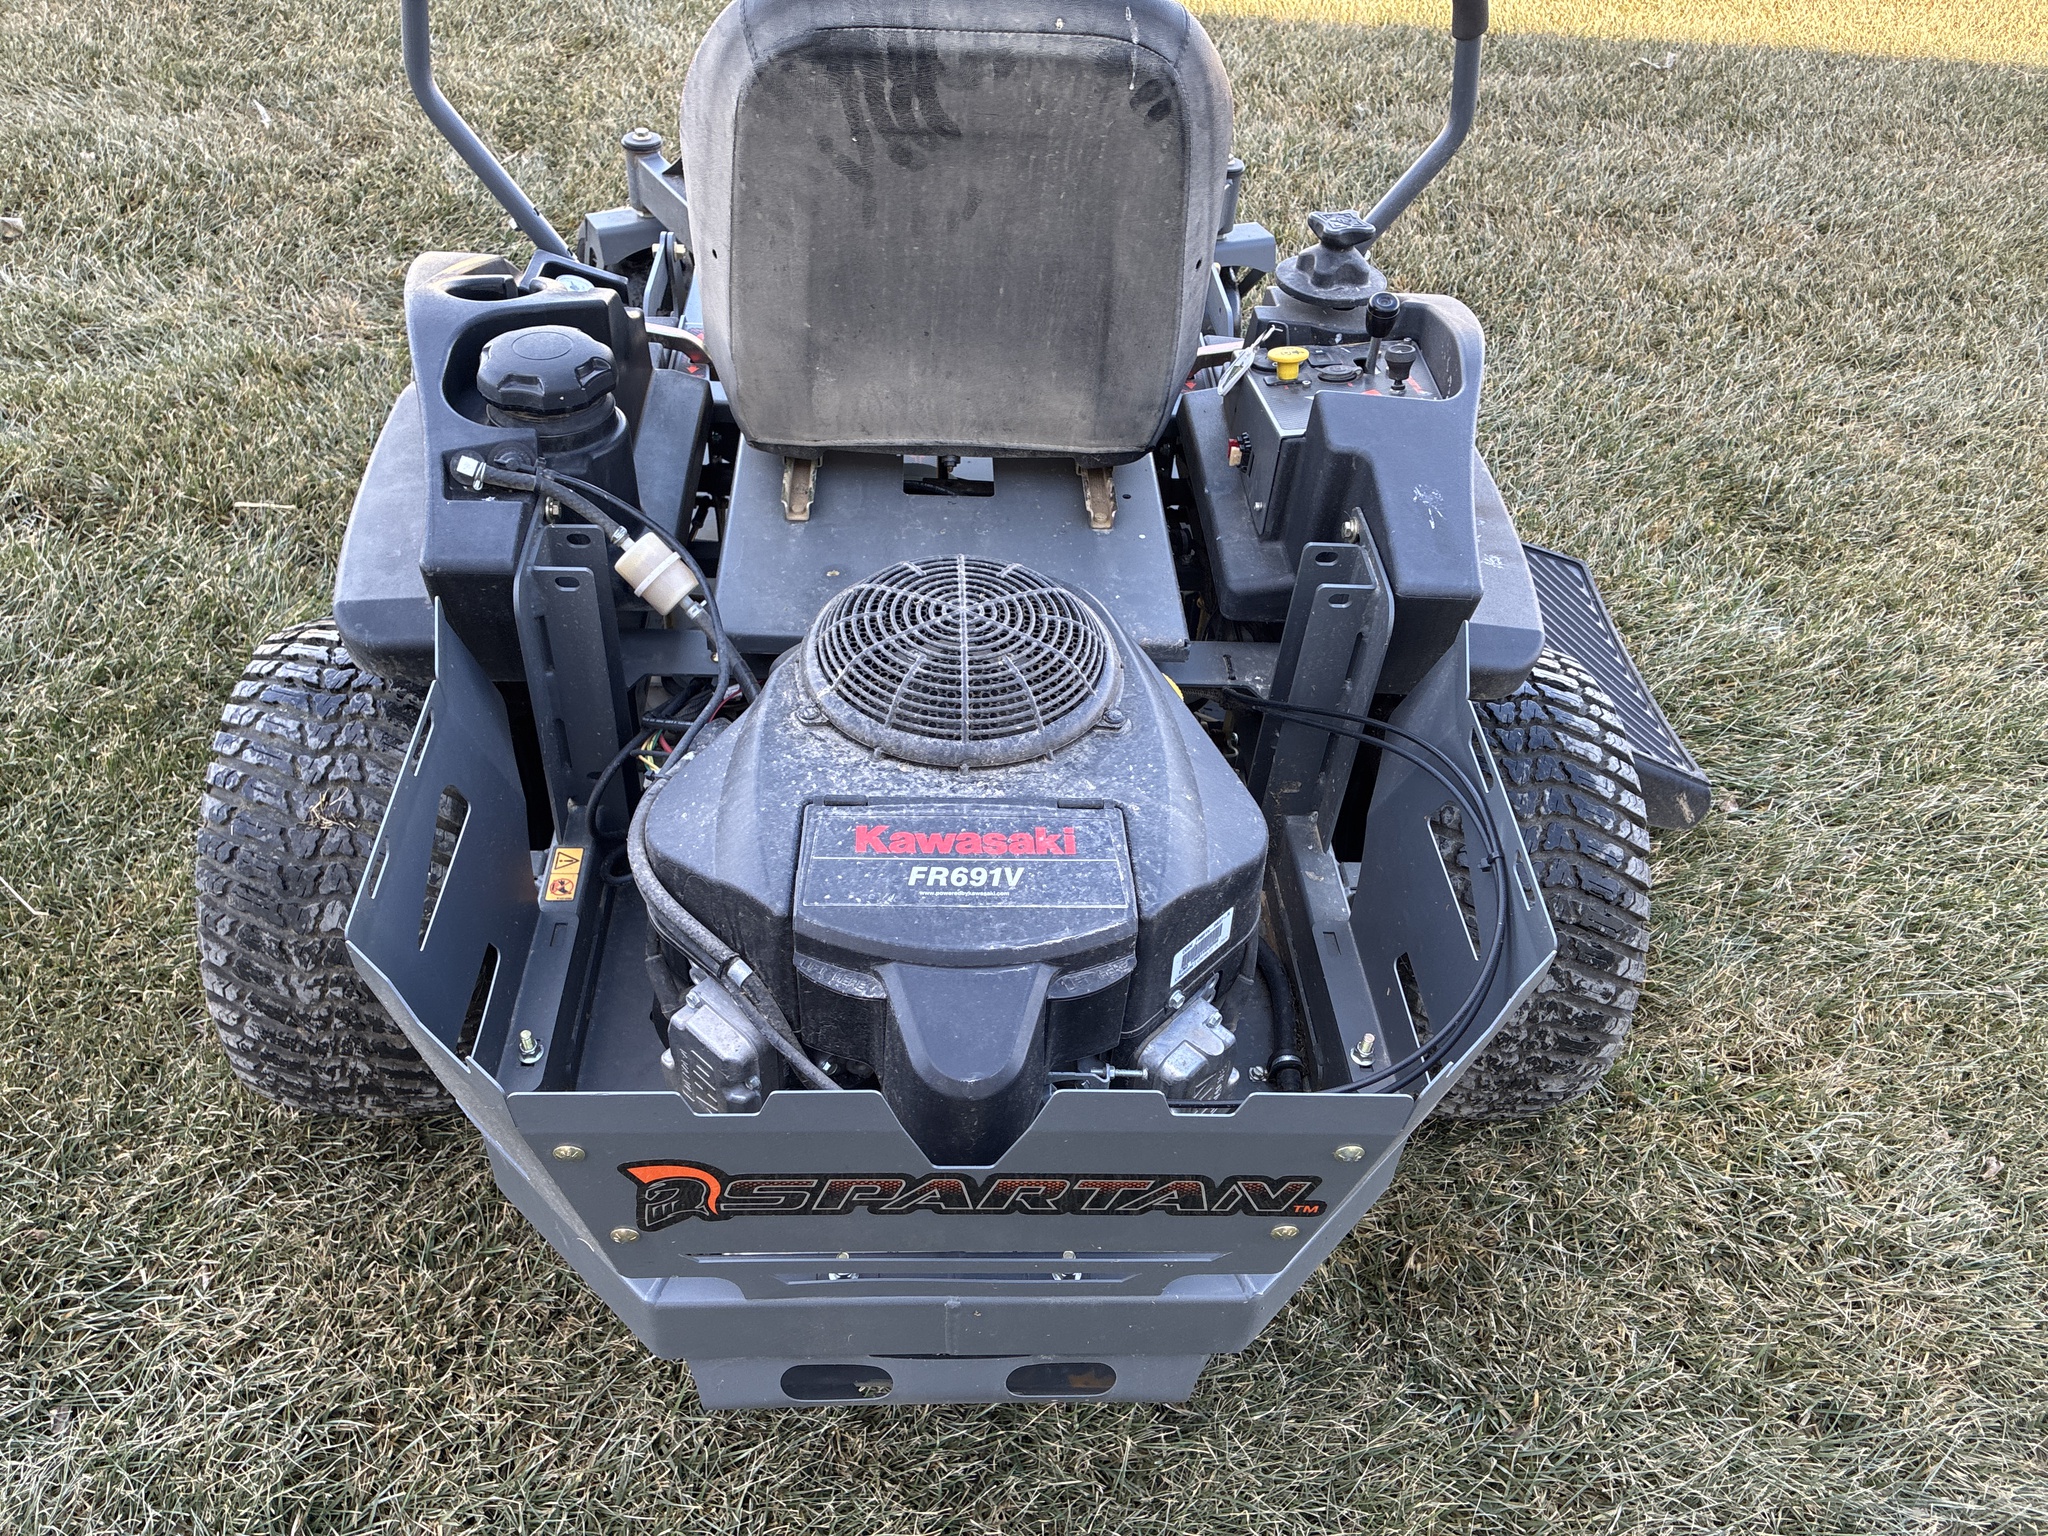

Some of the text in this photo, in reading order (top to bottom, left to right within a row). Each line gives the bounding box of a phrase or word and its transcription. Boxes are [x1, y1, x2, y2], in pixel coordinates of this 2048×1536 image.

[854, 824, 1077, 855] Kawasaki
[907, 866, 1025, 887] FR691V
[720, 1178, 1312, 1212] SPARTAN
